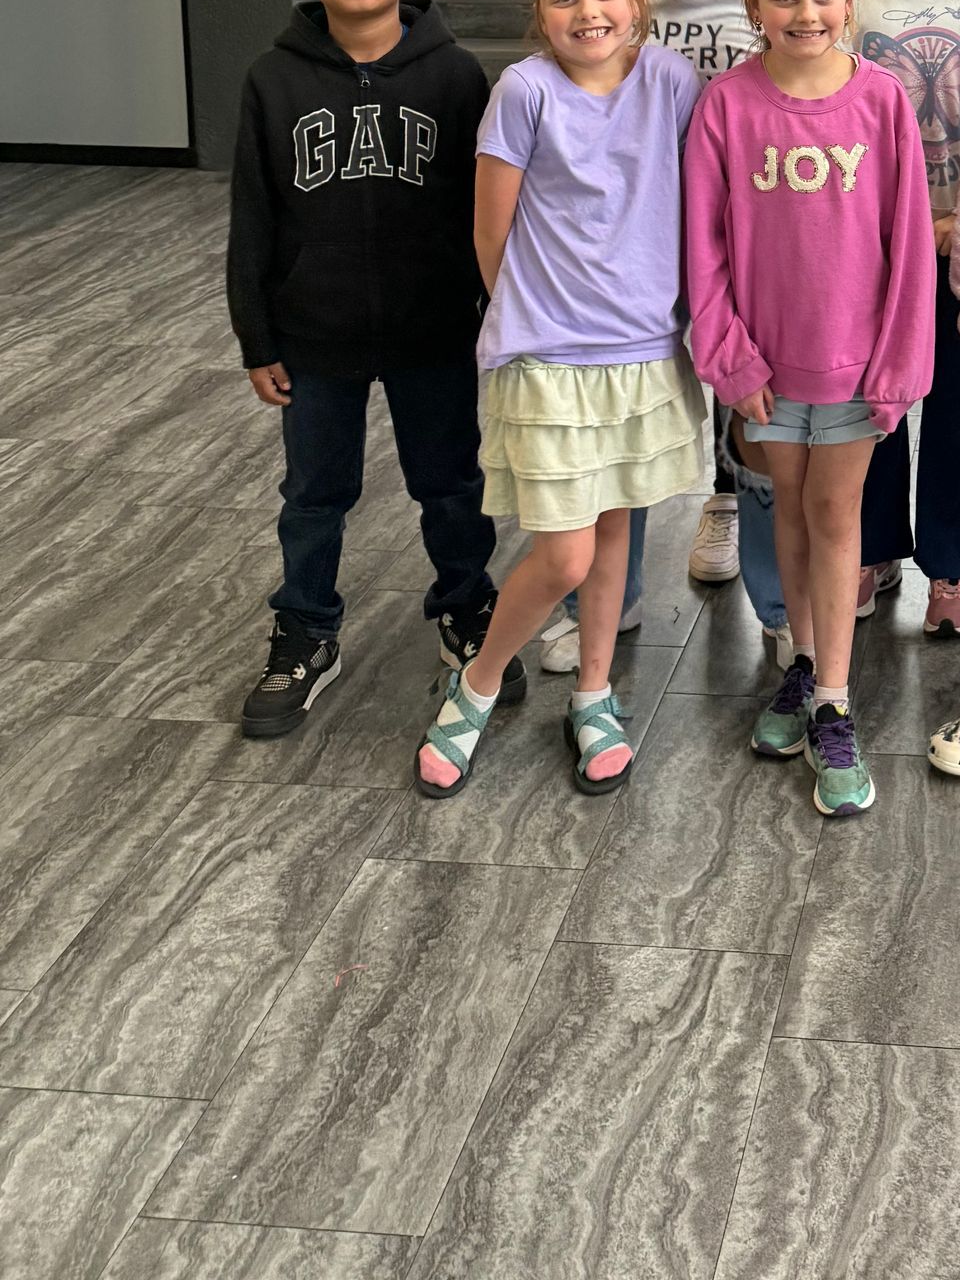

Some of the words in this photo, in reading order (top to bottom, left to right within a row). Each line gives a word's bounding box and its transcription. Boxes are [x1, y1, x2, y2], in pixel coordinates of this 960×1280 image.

[649, 18, 724, 48] APPY
[676, 44, 744, 70] ERY
[292, 104, 438, 193] GAP
[751, 142, 870, 194] JOY
